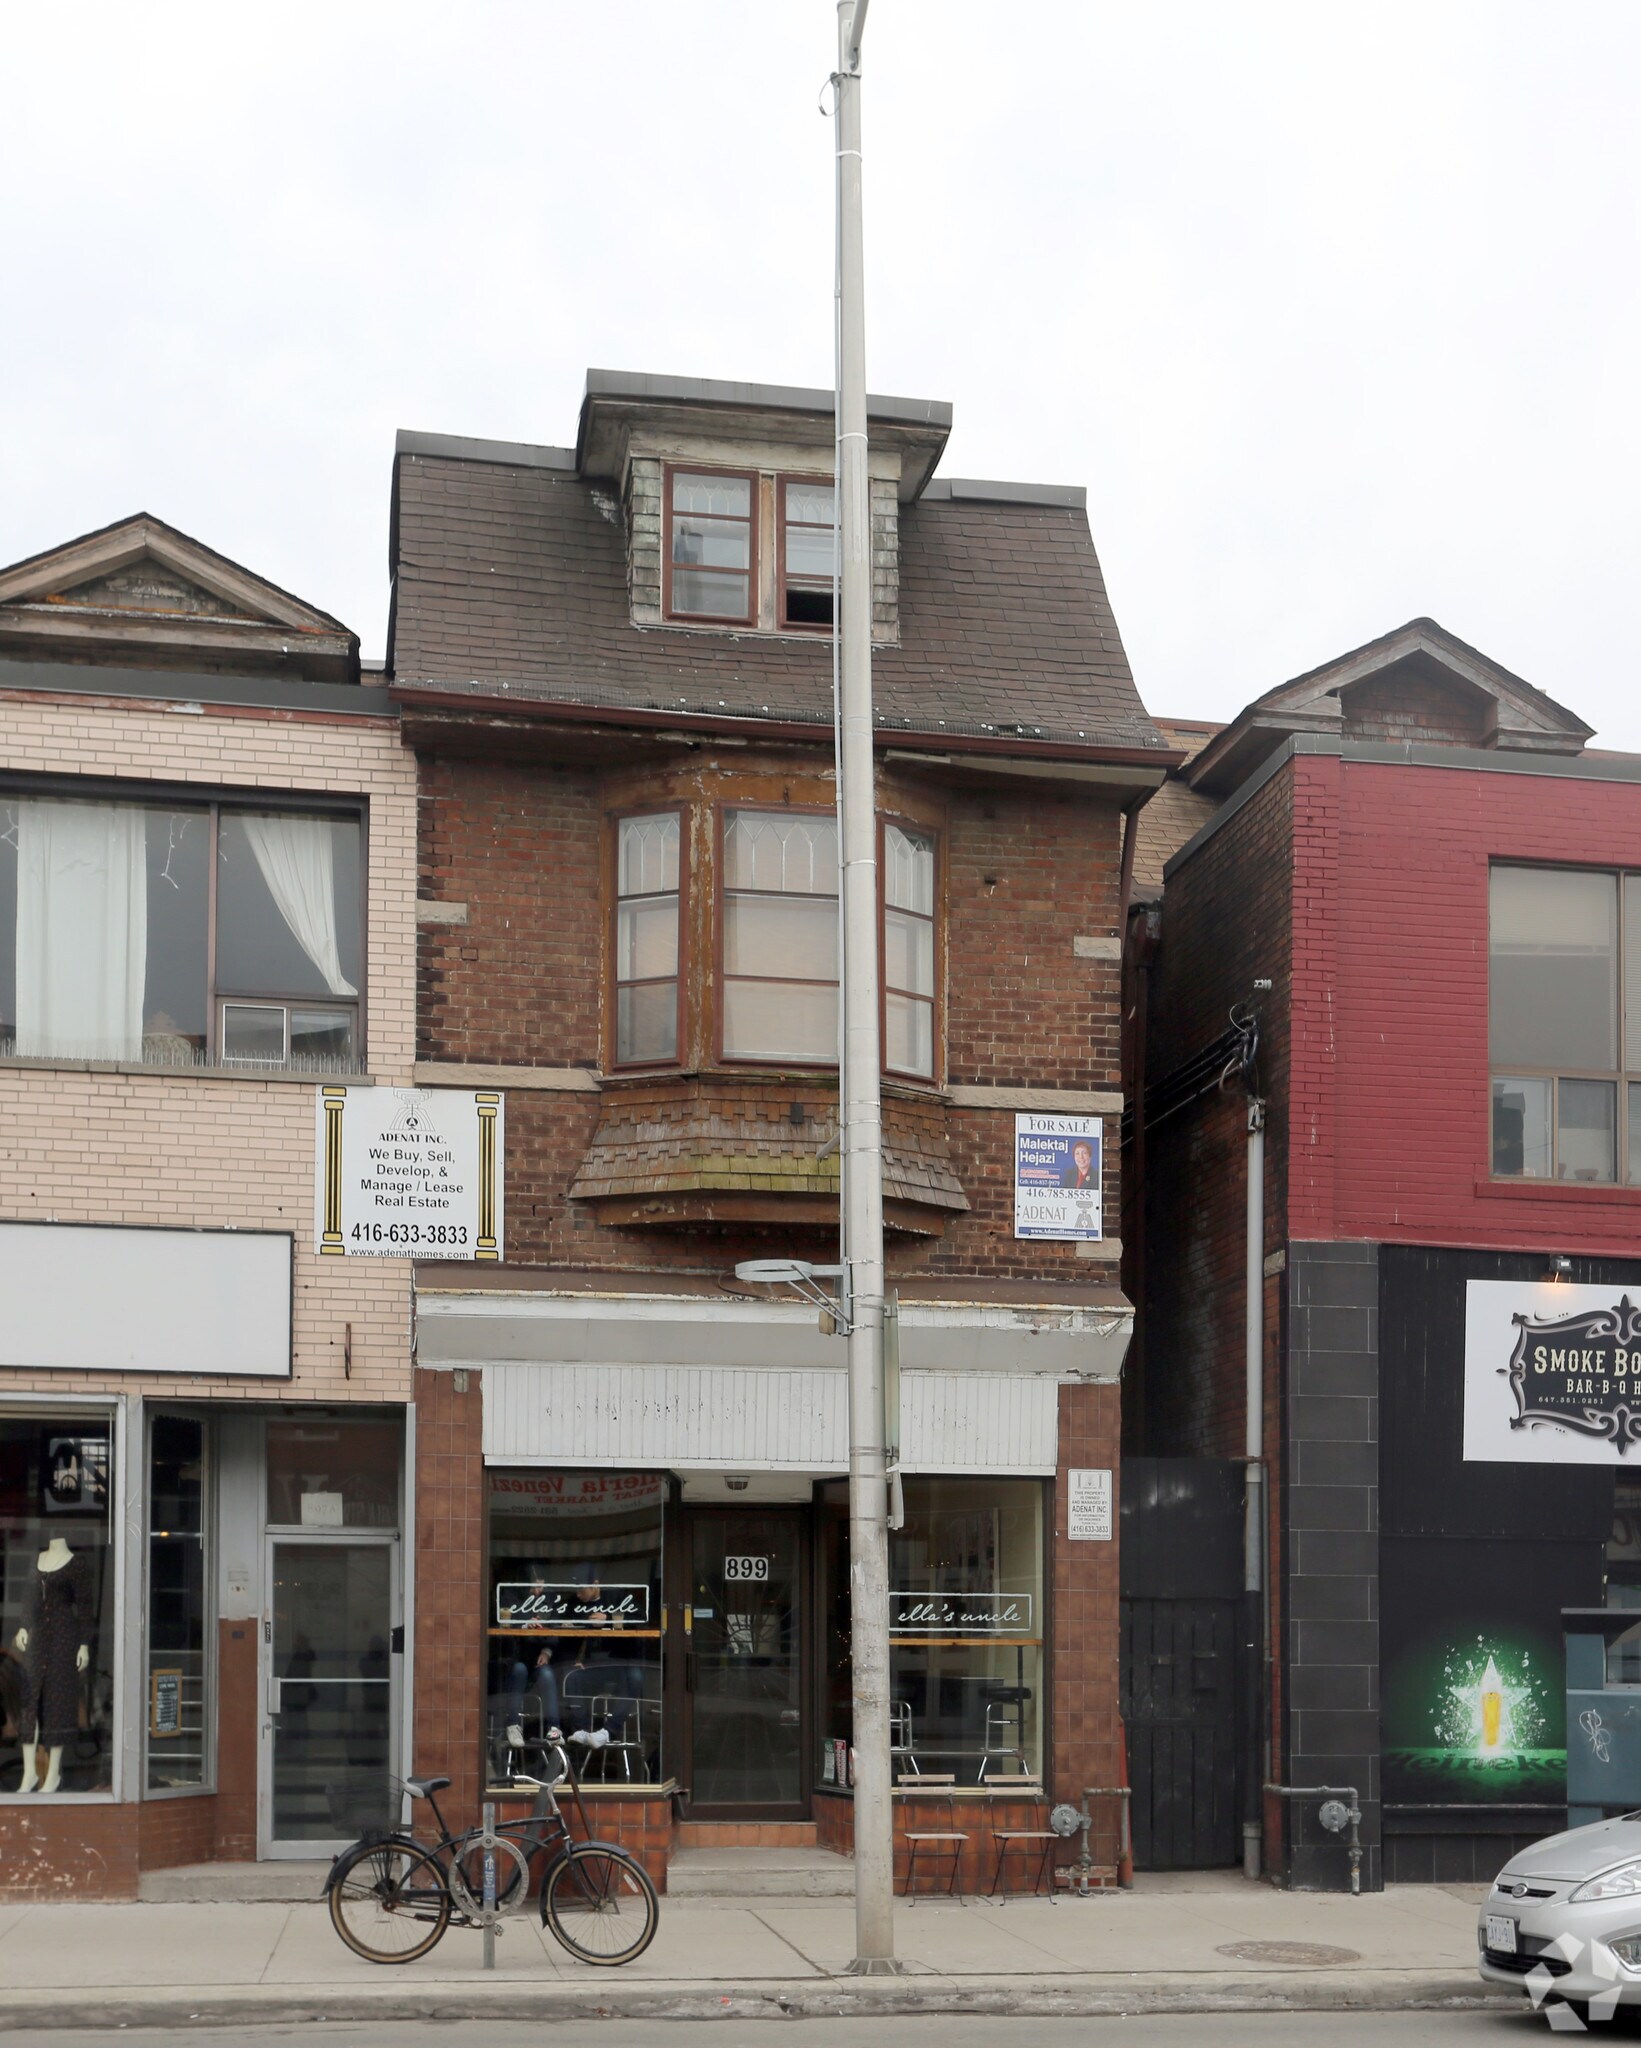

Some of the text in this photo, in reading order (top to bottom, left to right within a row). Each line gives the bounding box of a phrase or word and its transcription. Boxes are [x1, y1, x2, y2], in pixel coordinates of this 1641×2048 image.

[1030, 1119, 1090, 1133] FOR SALE
[379, 1133, 447, 1145] ADENAT INC.
[1020, 1137, 1068, 1153] Malektaj
[369, 1148, 456, 1164] We Buy, Sell,
[1020, 1151, 1055, 1165] Hejazi
[376, 1164, 449, 1178] Develop, &
[361, 1179, 412, 1194] Manage
[424, 1181, 464, 1194] Lease
[1026, 1188, 1091, 1200] 416.785.8555
[375, 1195, 450, 1208] Real Estate
[1022, 1206, 1067, 1220] ADENAT
[351, 1222, 468, 1245] 416-633-3833
[351, 1248, 469, 1260] www.adenathomes.com
[1534, 1345, 1606, 1374] SMOKE
[1566, 1379, 1626, 1394] BAR-B-Q
[1072, 1505, 1096, 1513] ADENAT
[1071, 1525, 1084, 1533] (416)
[727, 1558, 767, 1578] 899
[510, 1594, 638, 1614] ella's uncle
[898, 1603, 1022, 1622] ella's uncle
